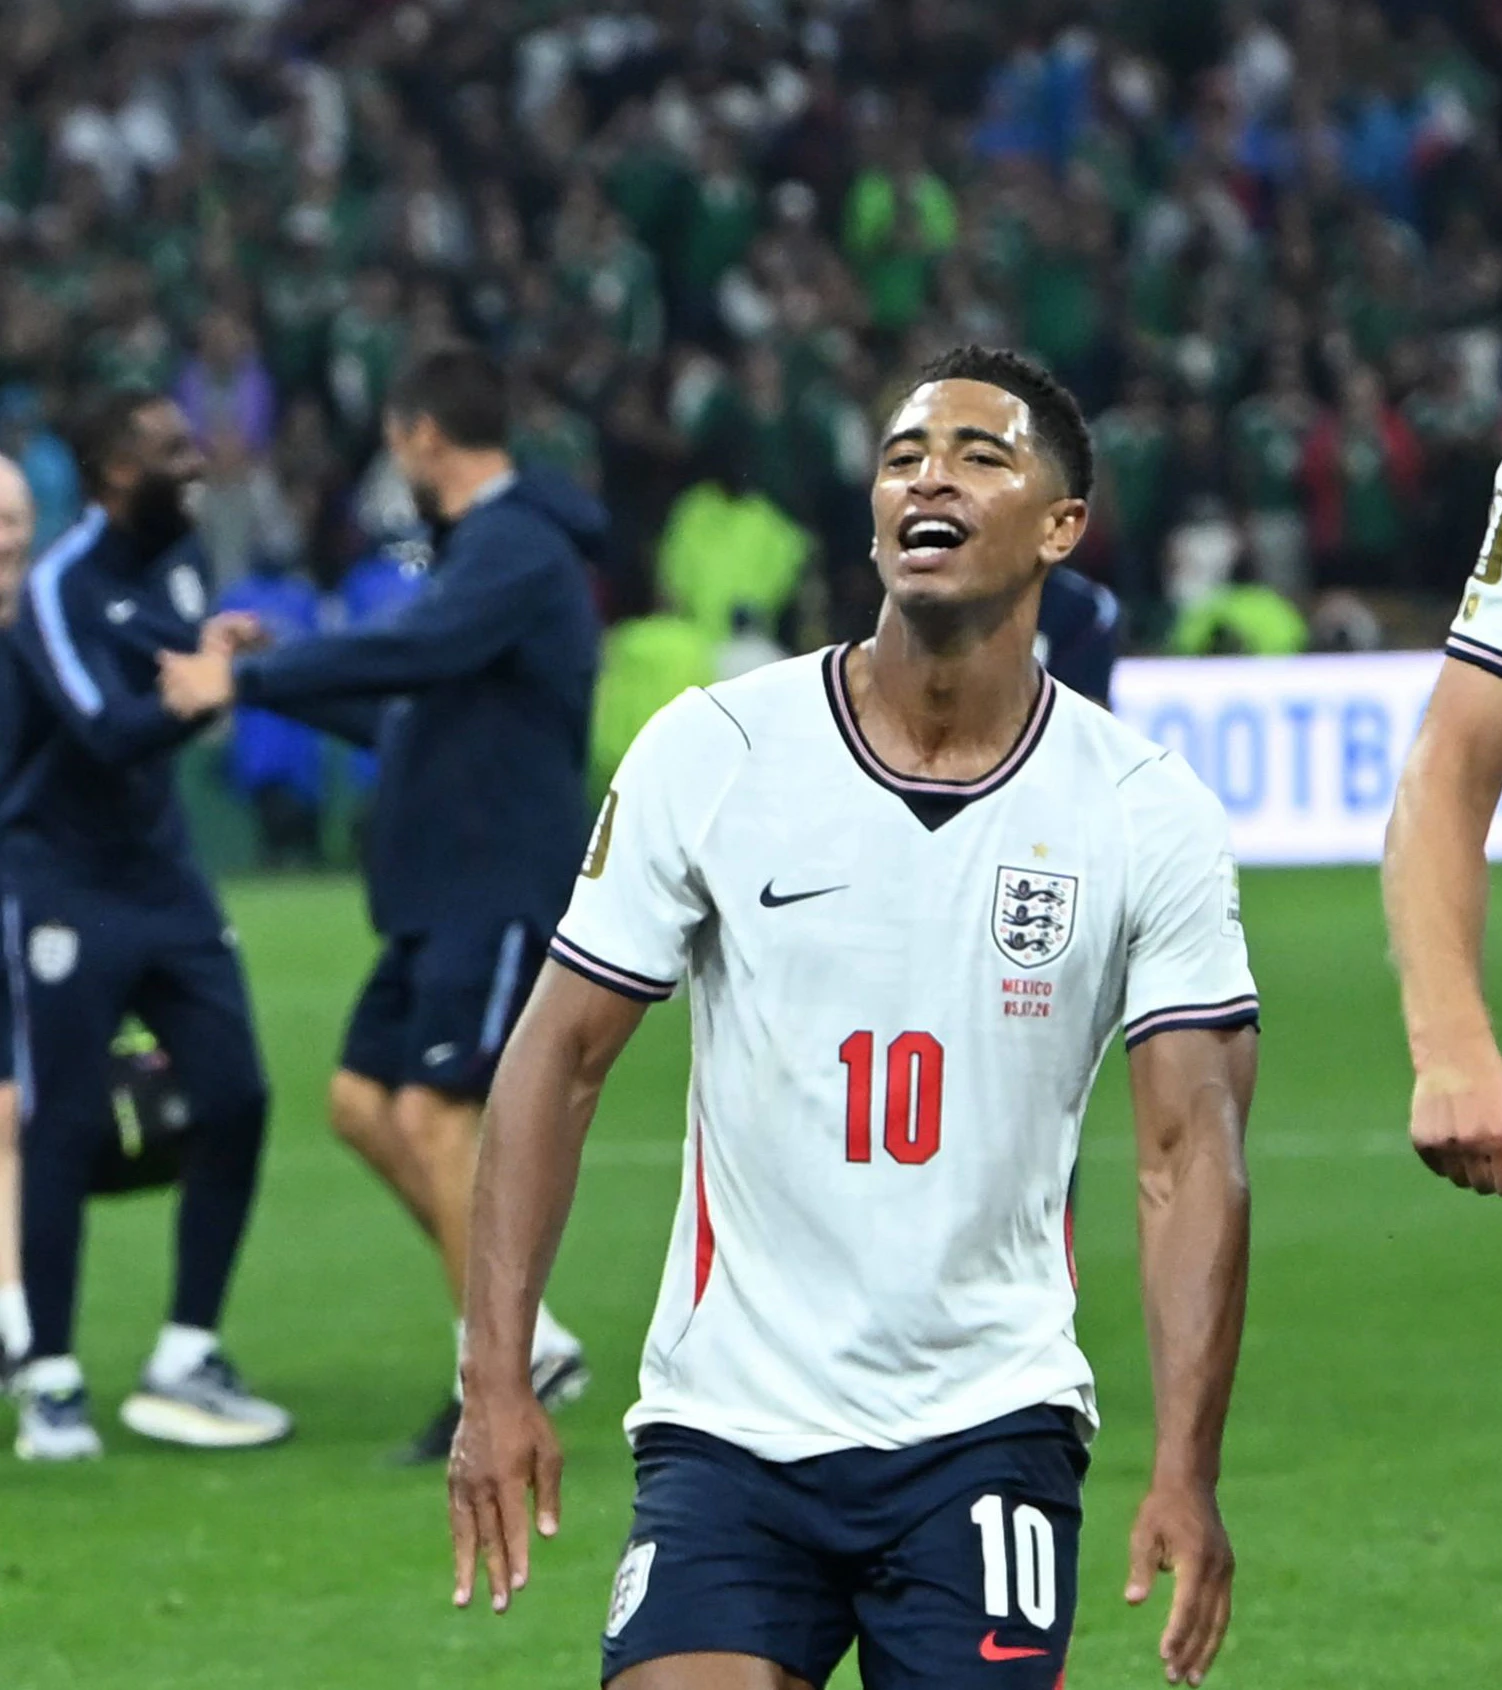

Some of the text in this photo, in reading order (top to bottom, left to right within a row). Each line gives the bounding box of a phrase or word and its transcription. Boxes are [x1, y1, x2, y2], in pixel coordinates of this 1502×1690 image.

[1002, 979, 1052, 997] MEXICO
[839, 1030, 944, 1165] 10
[970, 1494, 1056, 1630] 10
